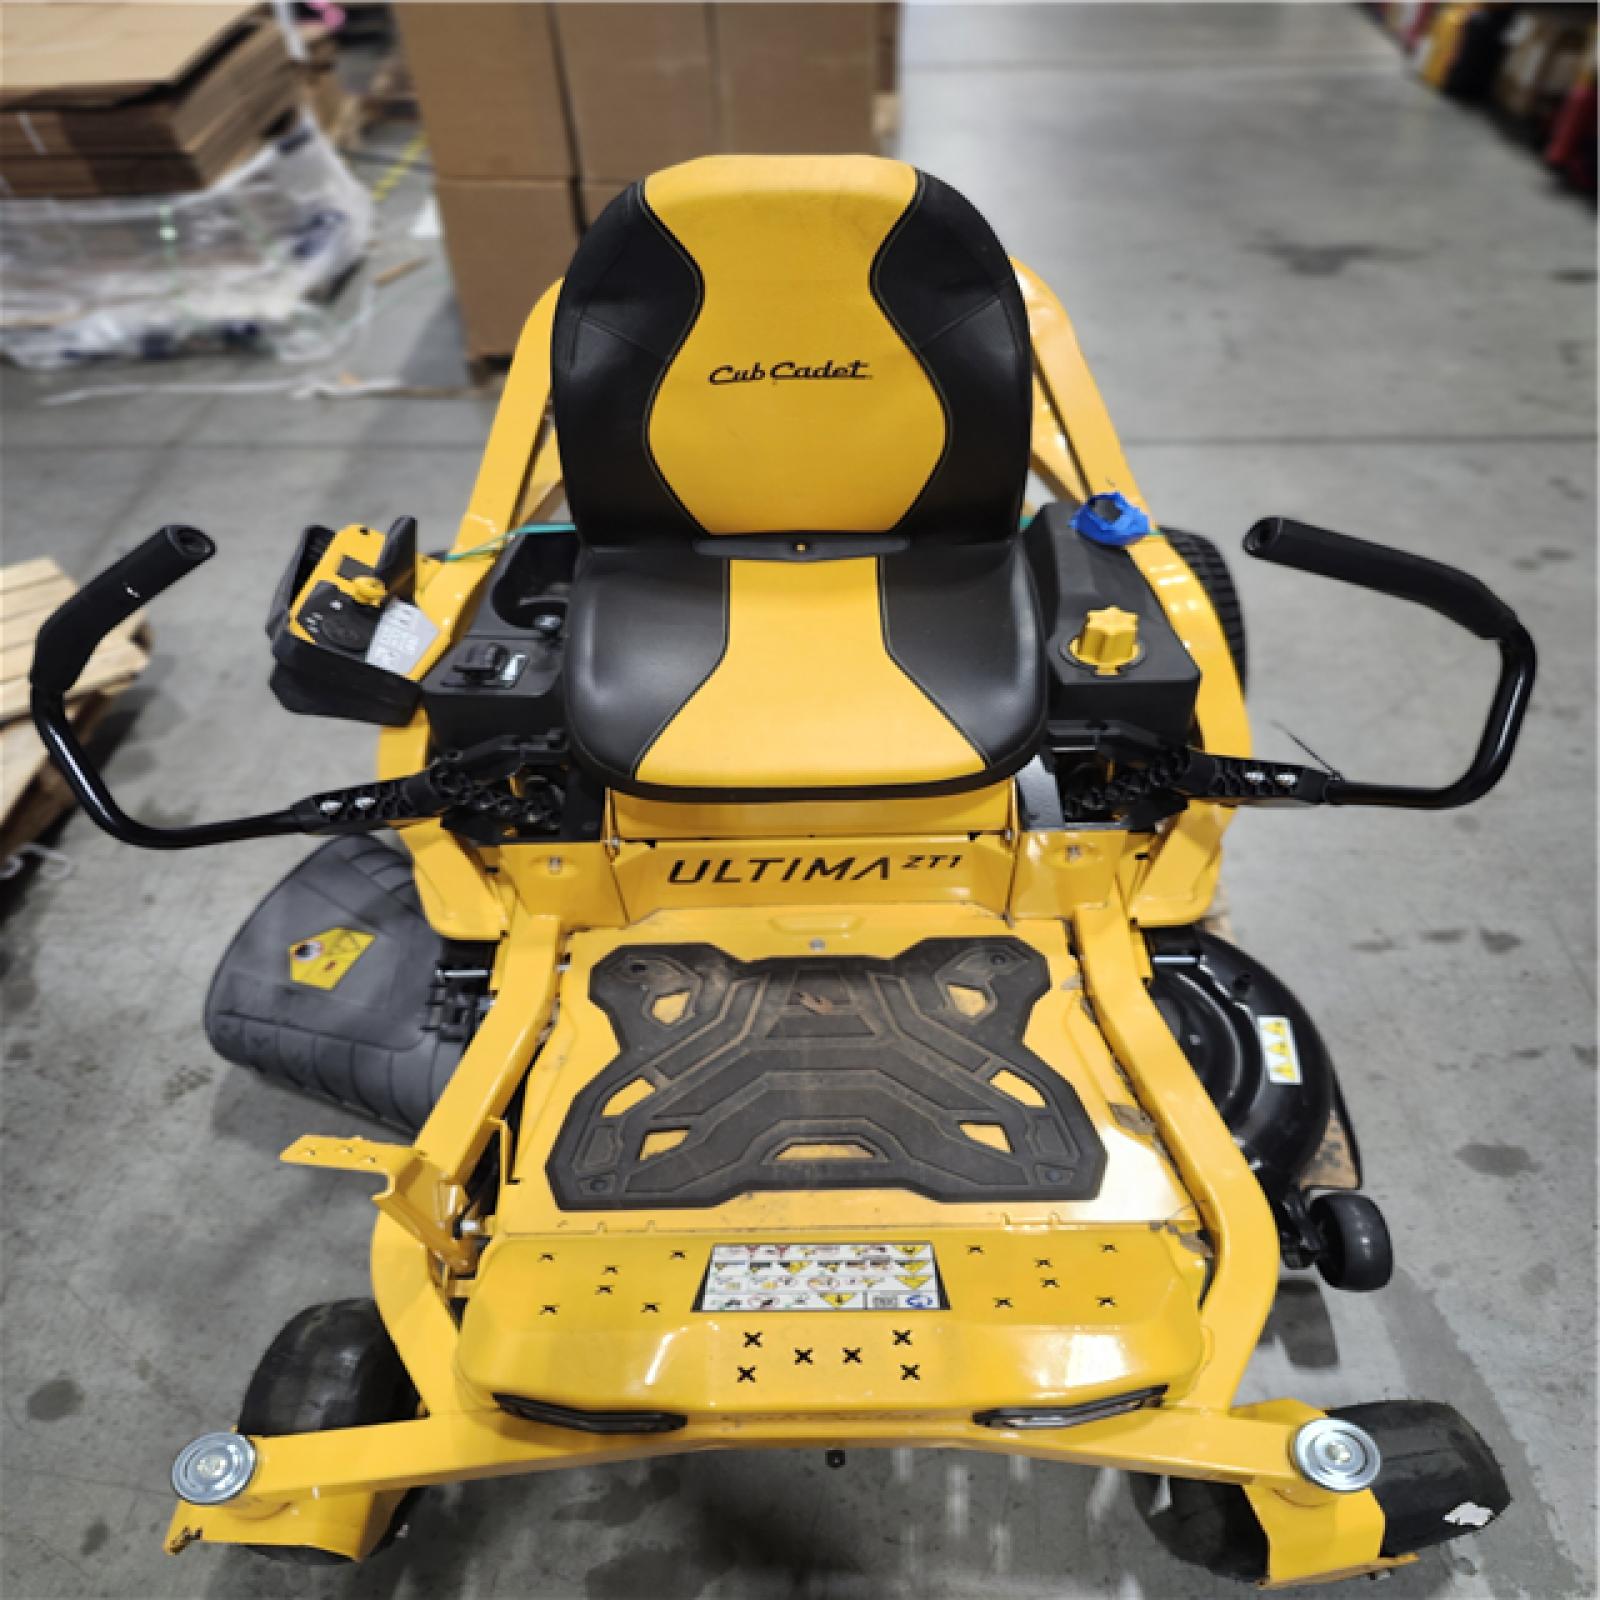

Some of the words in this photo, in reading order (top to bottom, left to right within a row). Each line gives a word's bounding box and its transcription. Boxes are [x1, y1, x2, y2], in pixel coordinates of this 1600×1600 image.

[708, 362, 766, 386] Cub
[770, 360, 873, 380] Cadet
[667, 857, 890, 883] ULTIMA
[901, 854, 963, 869] ZT1
